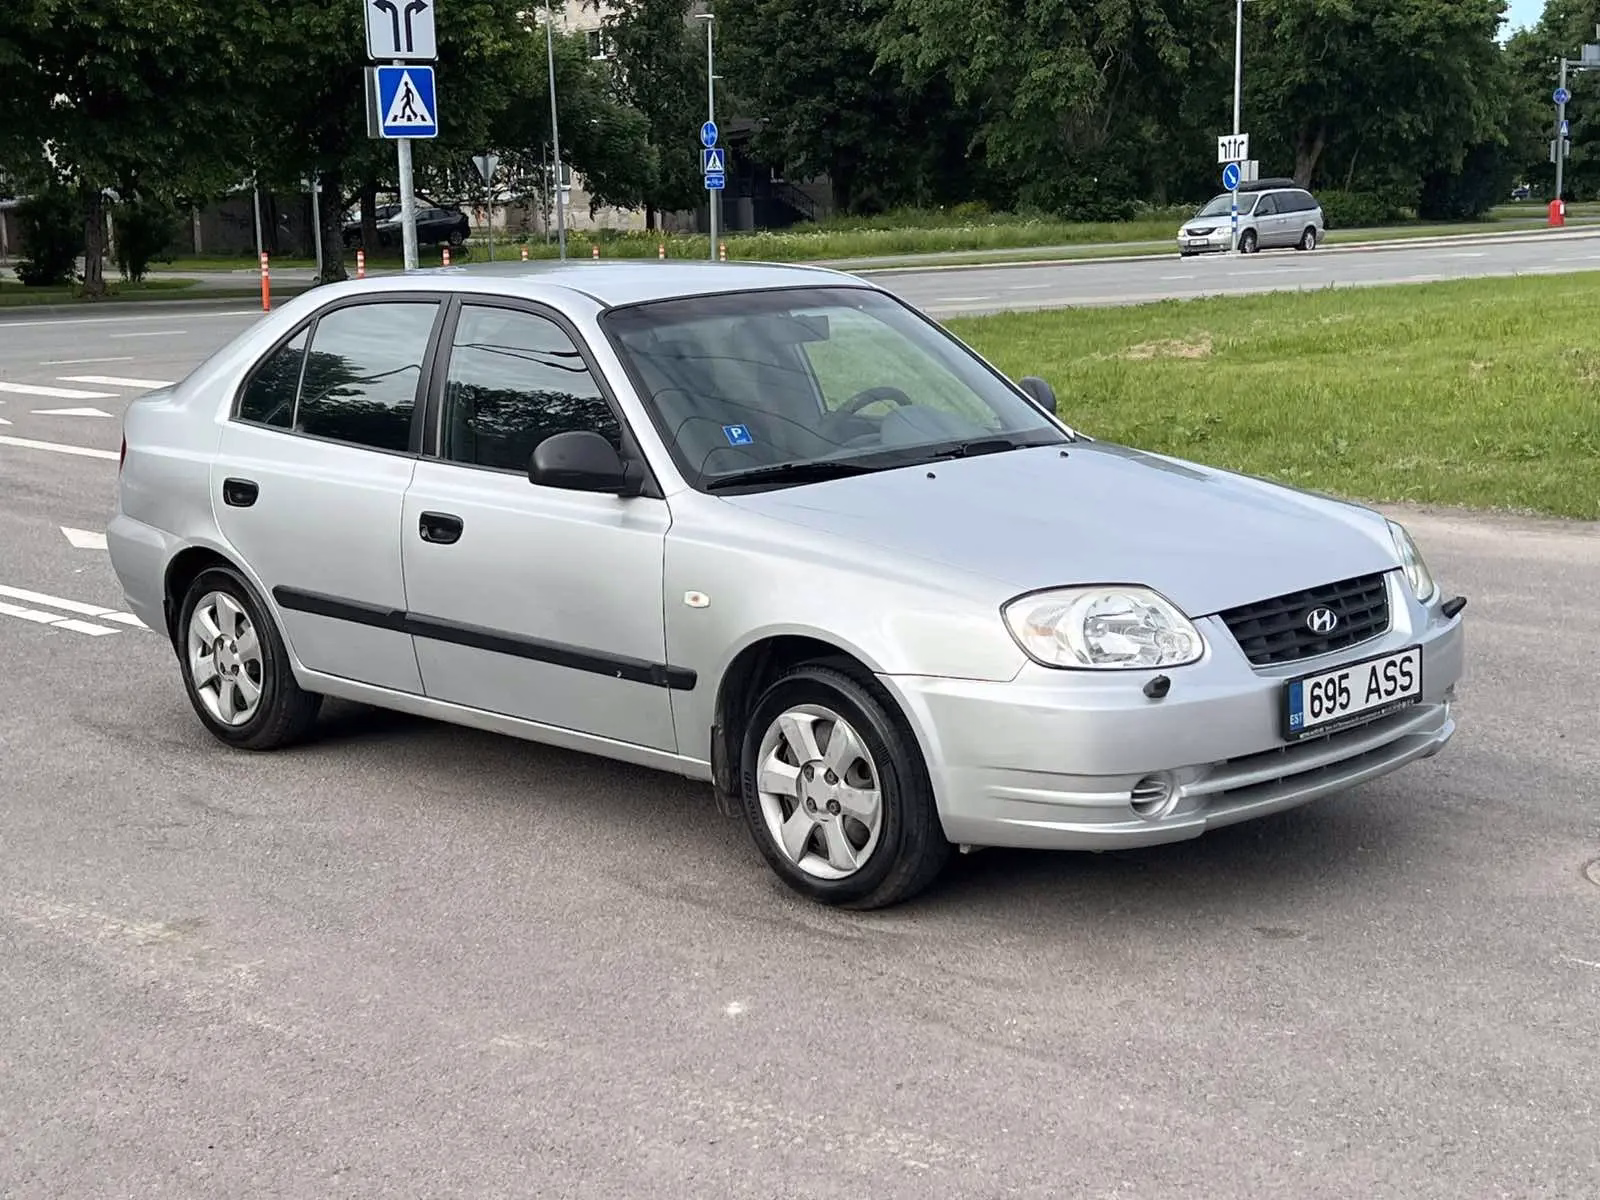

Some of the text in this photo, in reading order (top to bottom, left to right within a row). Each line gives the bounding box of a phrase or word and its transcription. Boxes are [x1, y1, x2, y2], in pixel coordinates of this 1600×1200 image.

[731, 428, 742, 438] P
[1310, 672, 1350, 719] 695
[1365, 655, 1413, 704] ASS
[1289, 712, 1304, 726] EST
